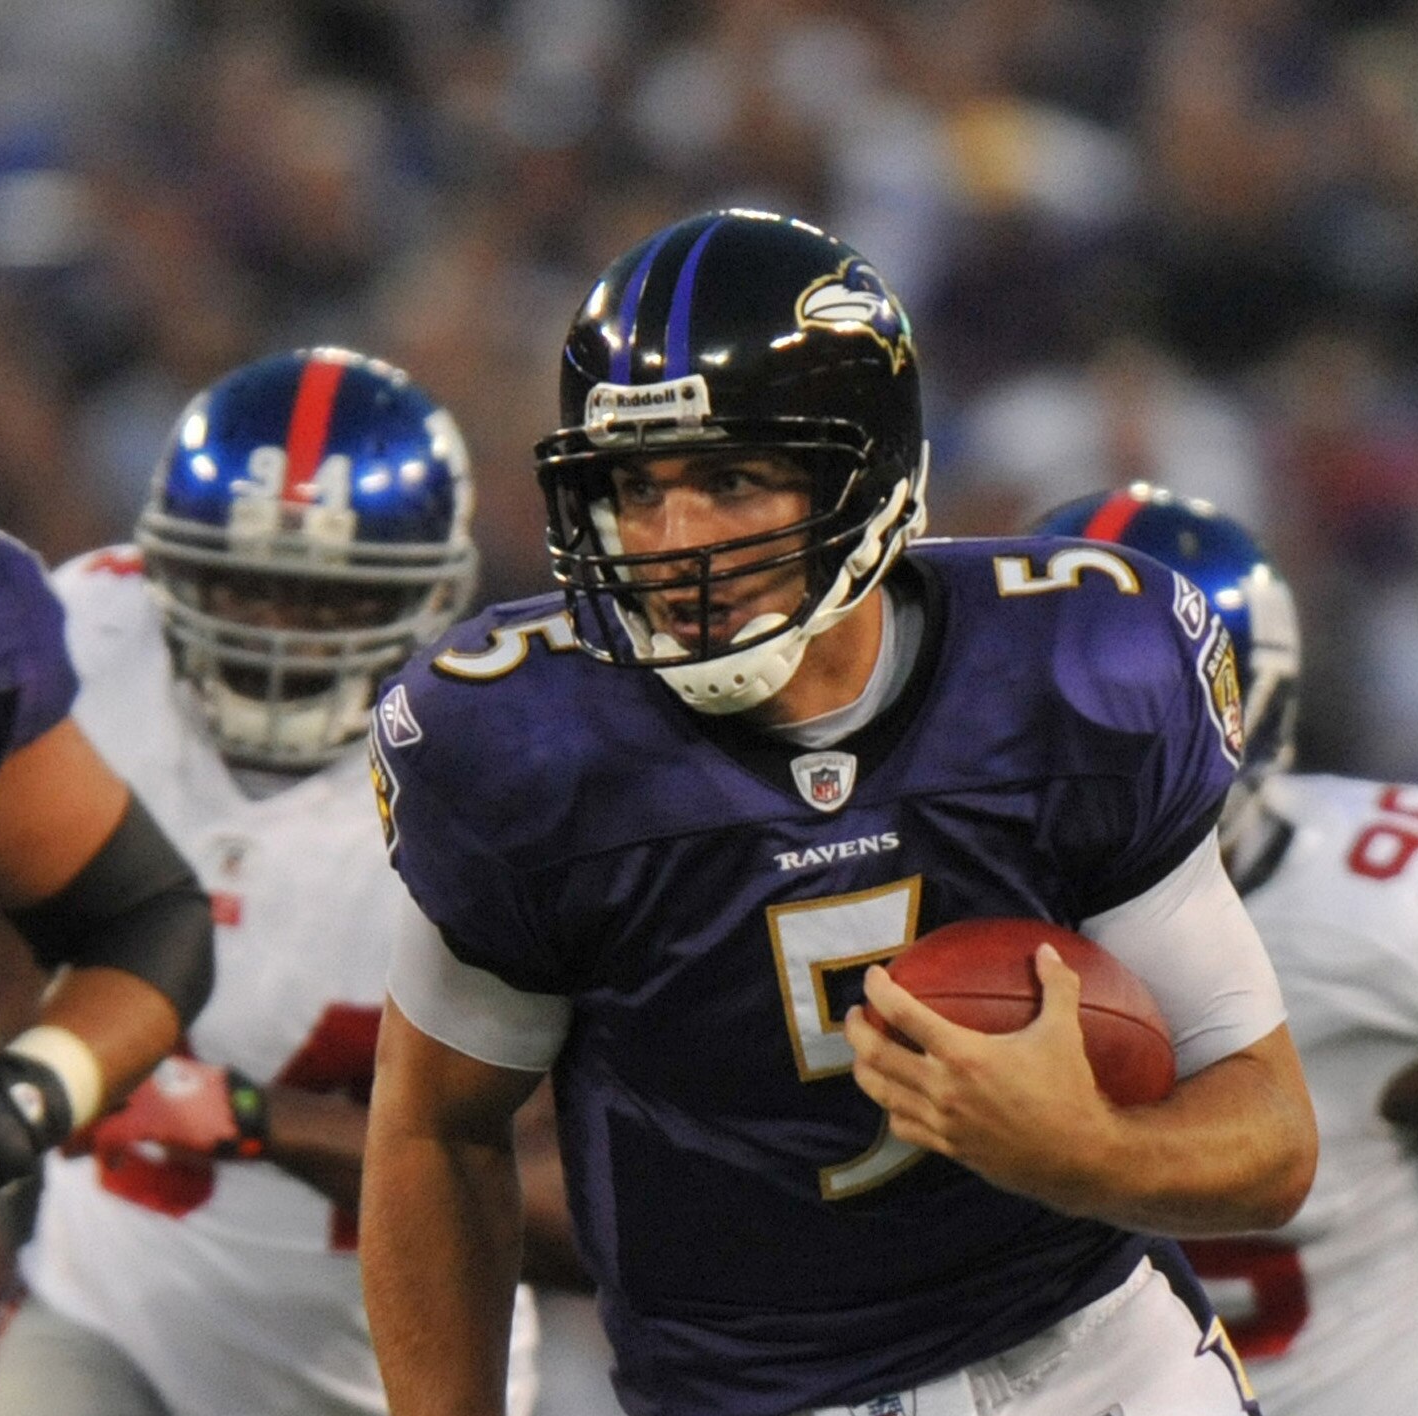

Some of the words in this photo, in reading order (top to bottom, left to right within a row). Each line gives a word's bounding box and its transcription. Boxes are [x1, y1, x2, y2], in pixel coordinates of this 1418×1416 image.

[616, 389, 676, 407] Riddell
[992, 548, 1141, 598] 5
[432, 609, 579, 679] 5
[773, 832, 900, 871] RAVENS
